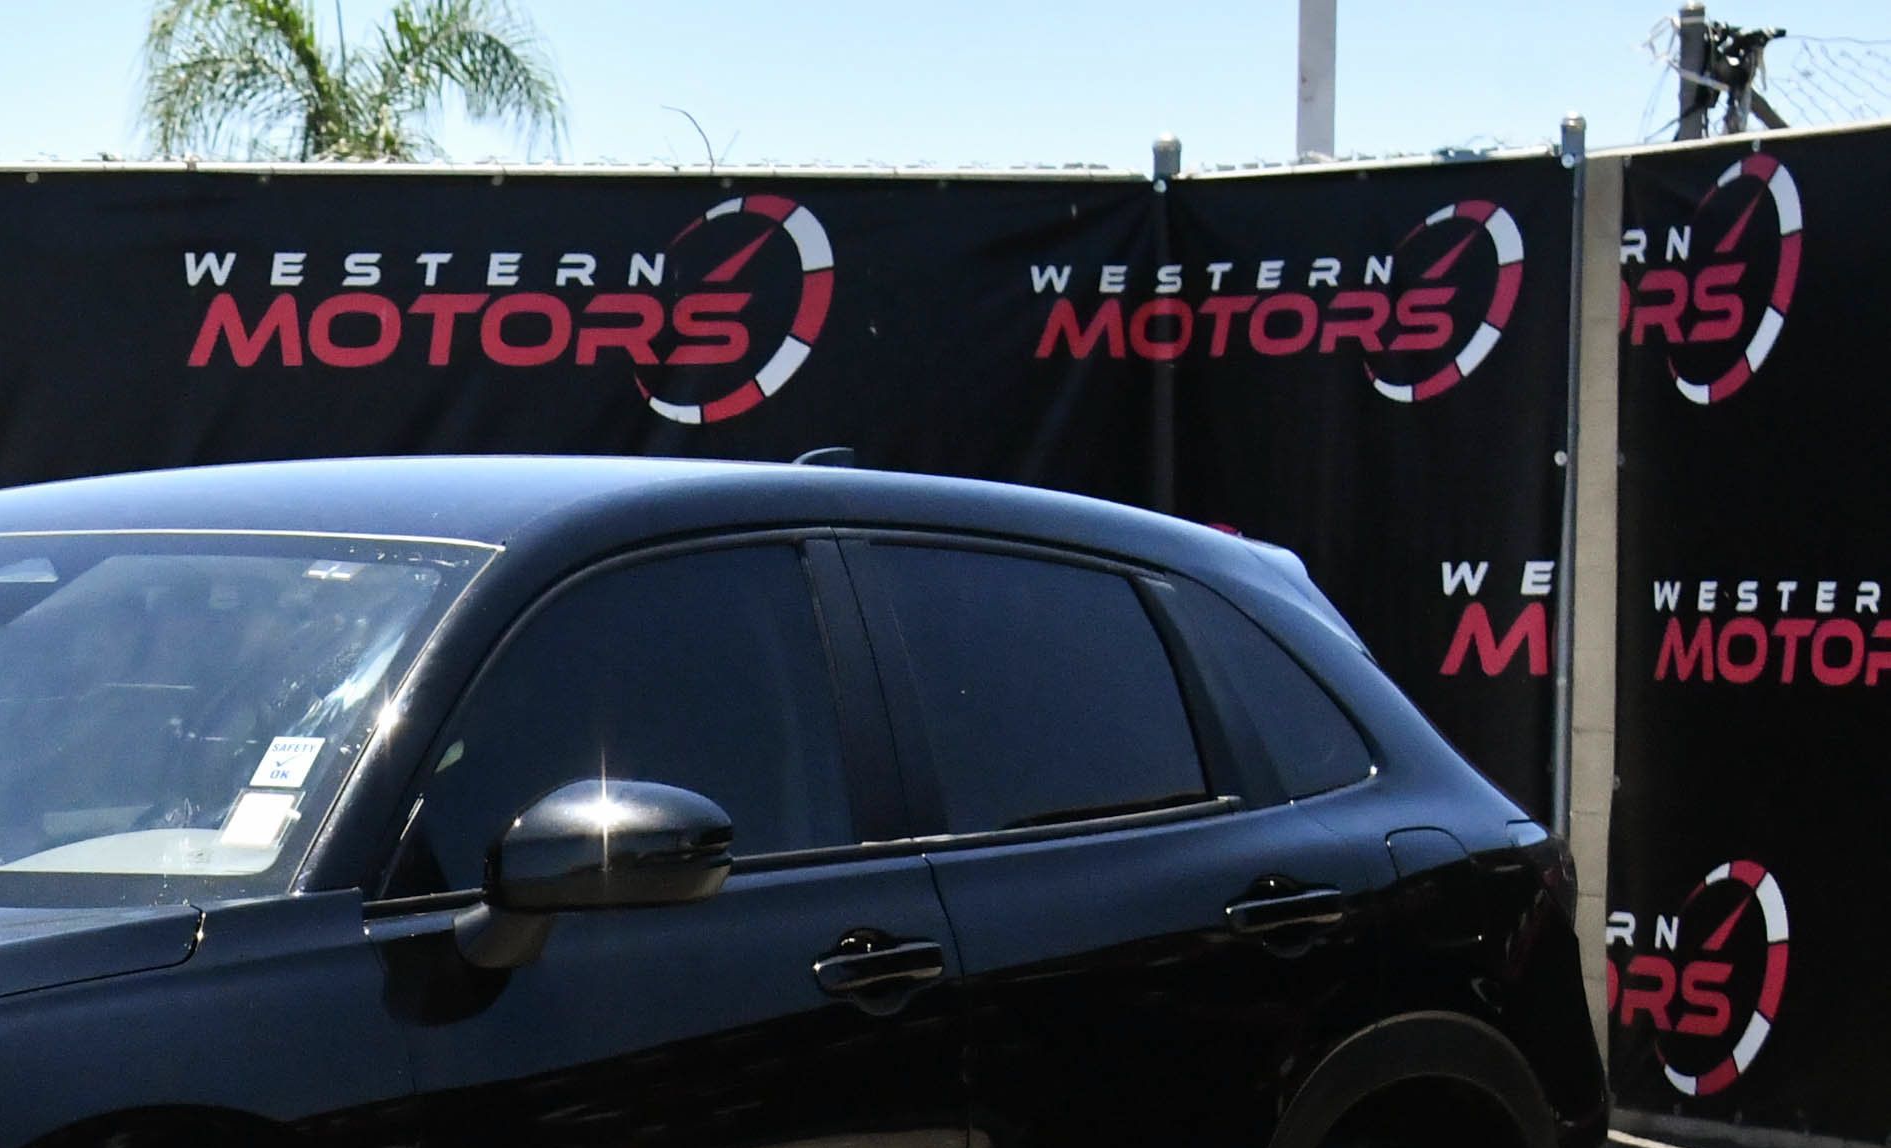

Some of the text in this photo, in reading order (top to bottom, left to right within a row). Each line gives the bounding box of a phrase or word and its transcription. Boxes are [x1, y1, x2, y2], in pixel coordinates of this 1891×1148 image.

[185, 251, 666, 287] WESTERN
[1030, 254, 1394, 294] WESTERN
[1032, 286, 1457, 361] MOTORS
[1619, 262, 1747, 346] RS
[188, 291, 752, 369] MOTORS
[1653, 580, 1882, 614] WESTER
[271, 743, 316, 753] SAFETY
[270, 770, 290, 779] OK
[1606, 955, 1734, 1037] RS
